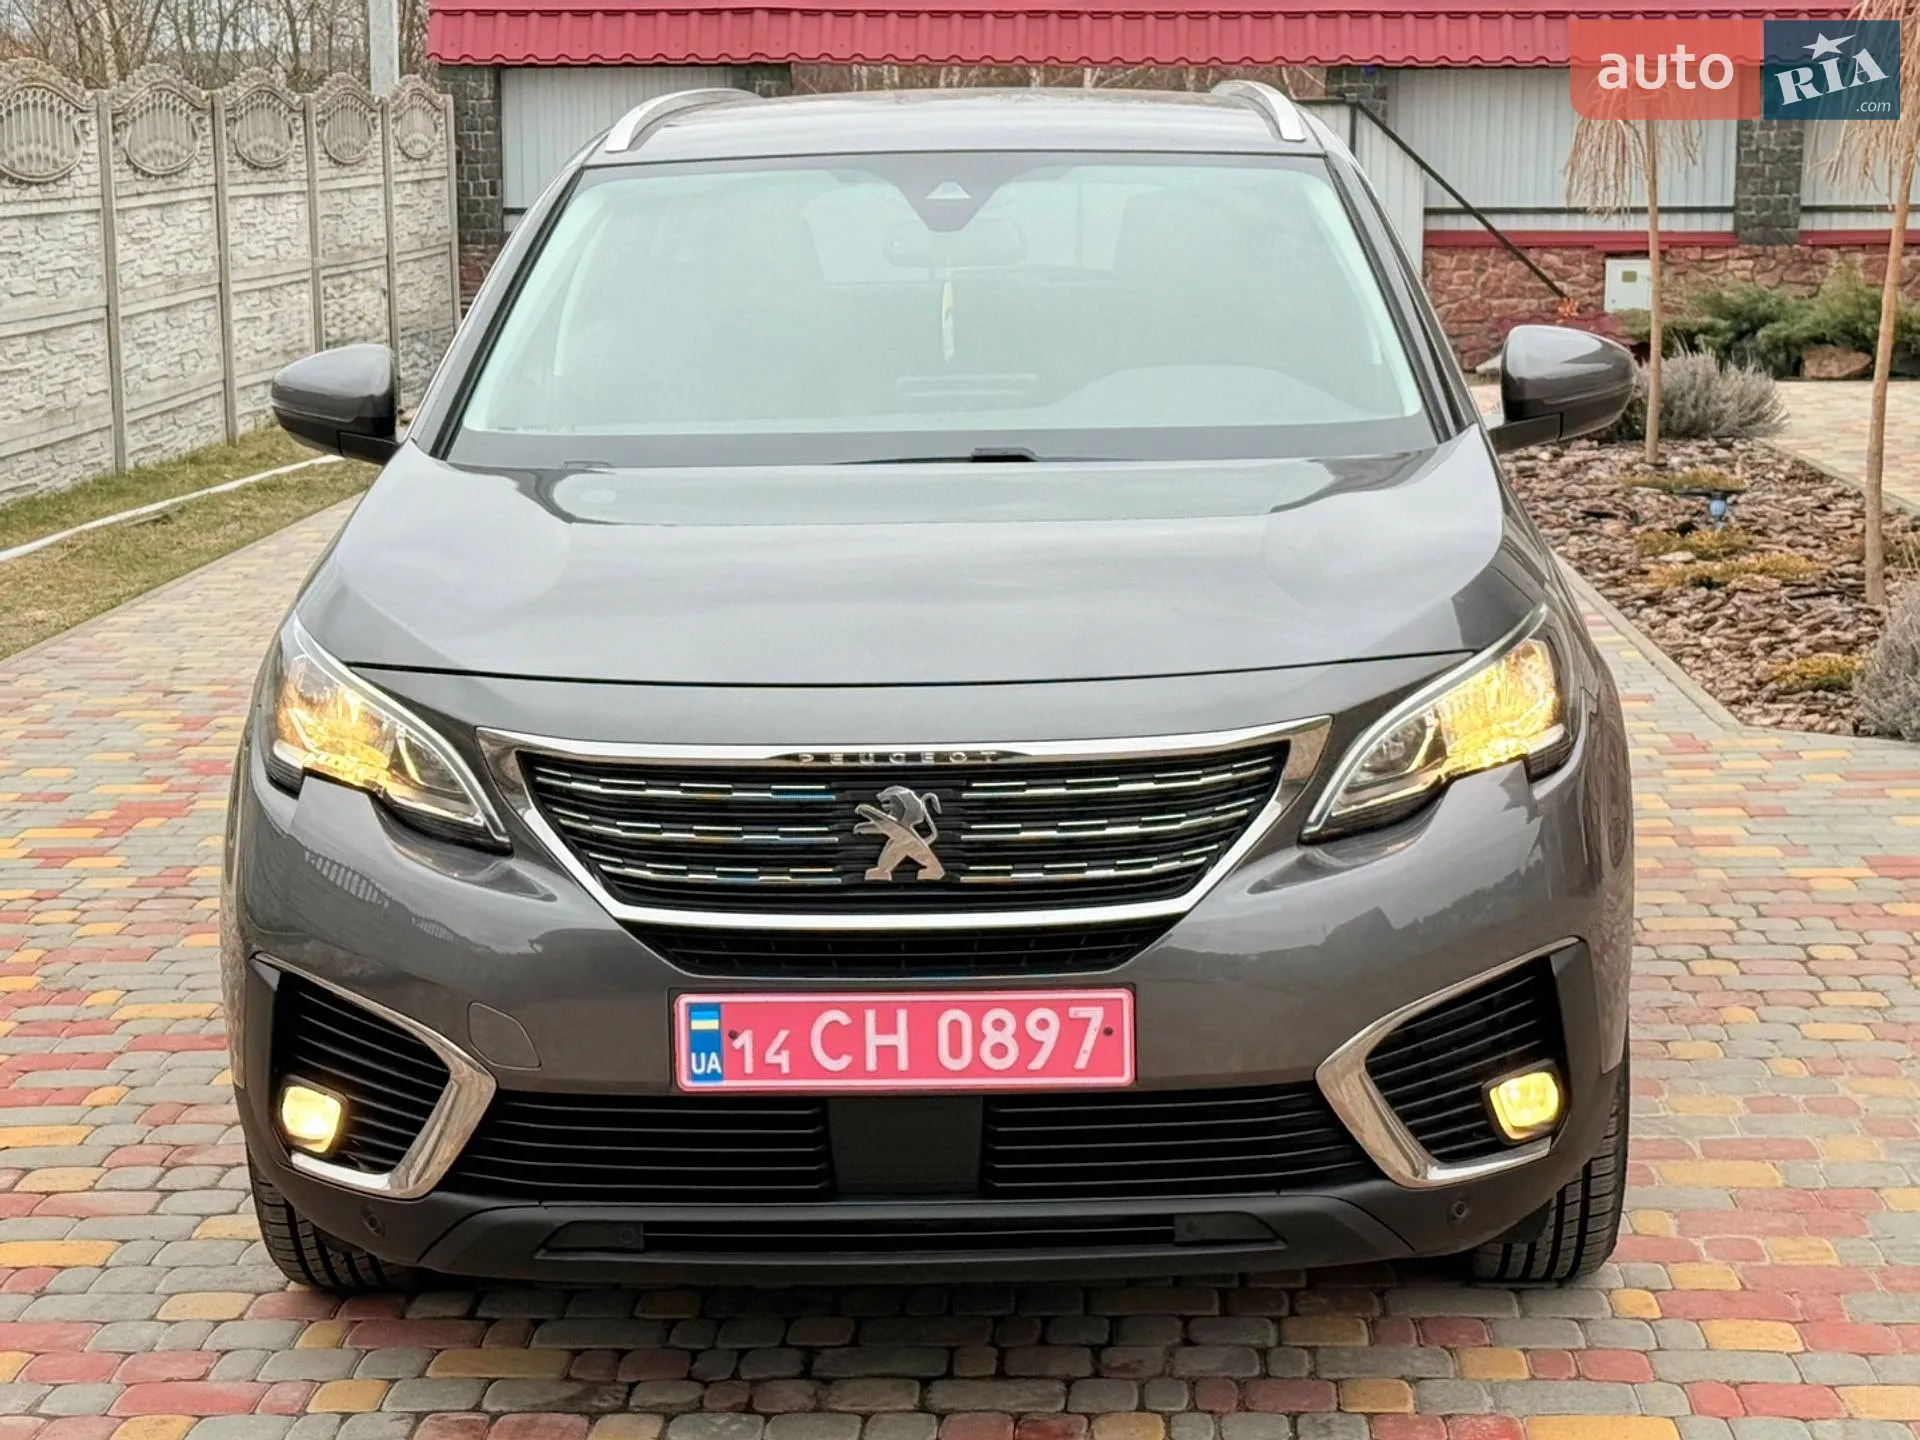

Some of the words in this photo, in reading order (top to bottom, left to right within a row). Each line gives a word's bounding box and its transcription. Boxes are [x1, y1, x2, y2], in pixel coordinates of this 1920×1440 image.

[798, 751, 997, 764] PEUGEOT
[731, 1028, 792, 1075] 14
[809, 1008, 910, 1073] CH
[936, 1005, 1105, 1073] 0897
[690, 1052, 722, 1075] UA
